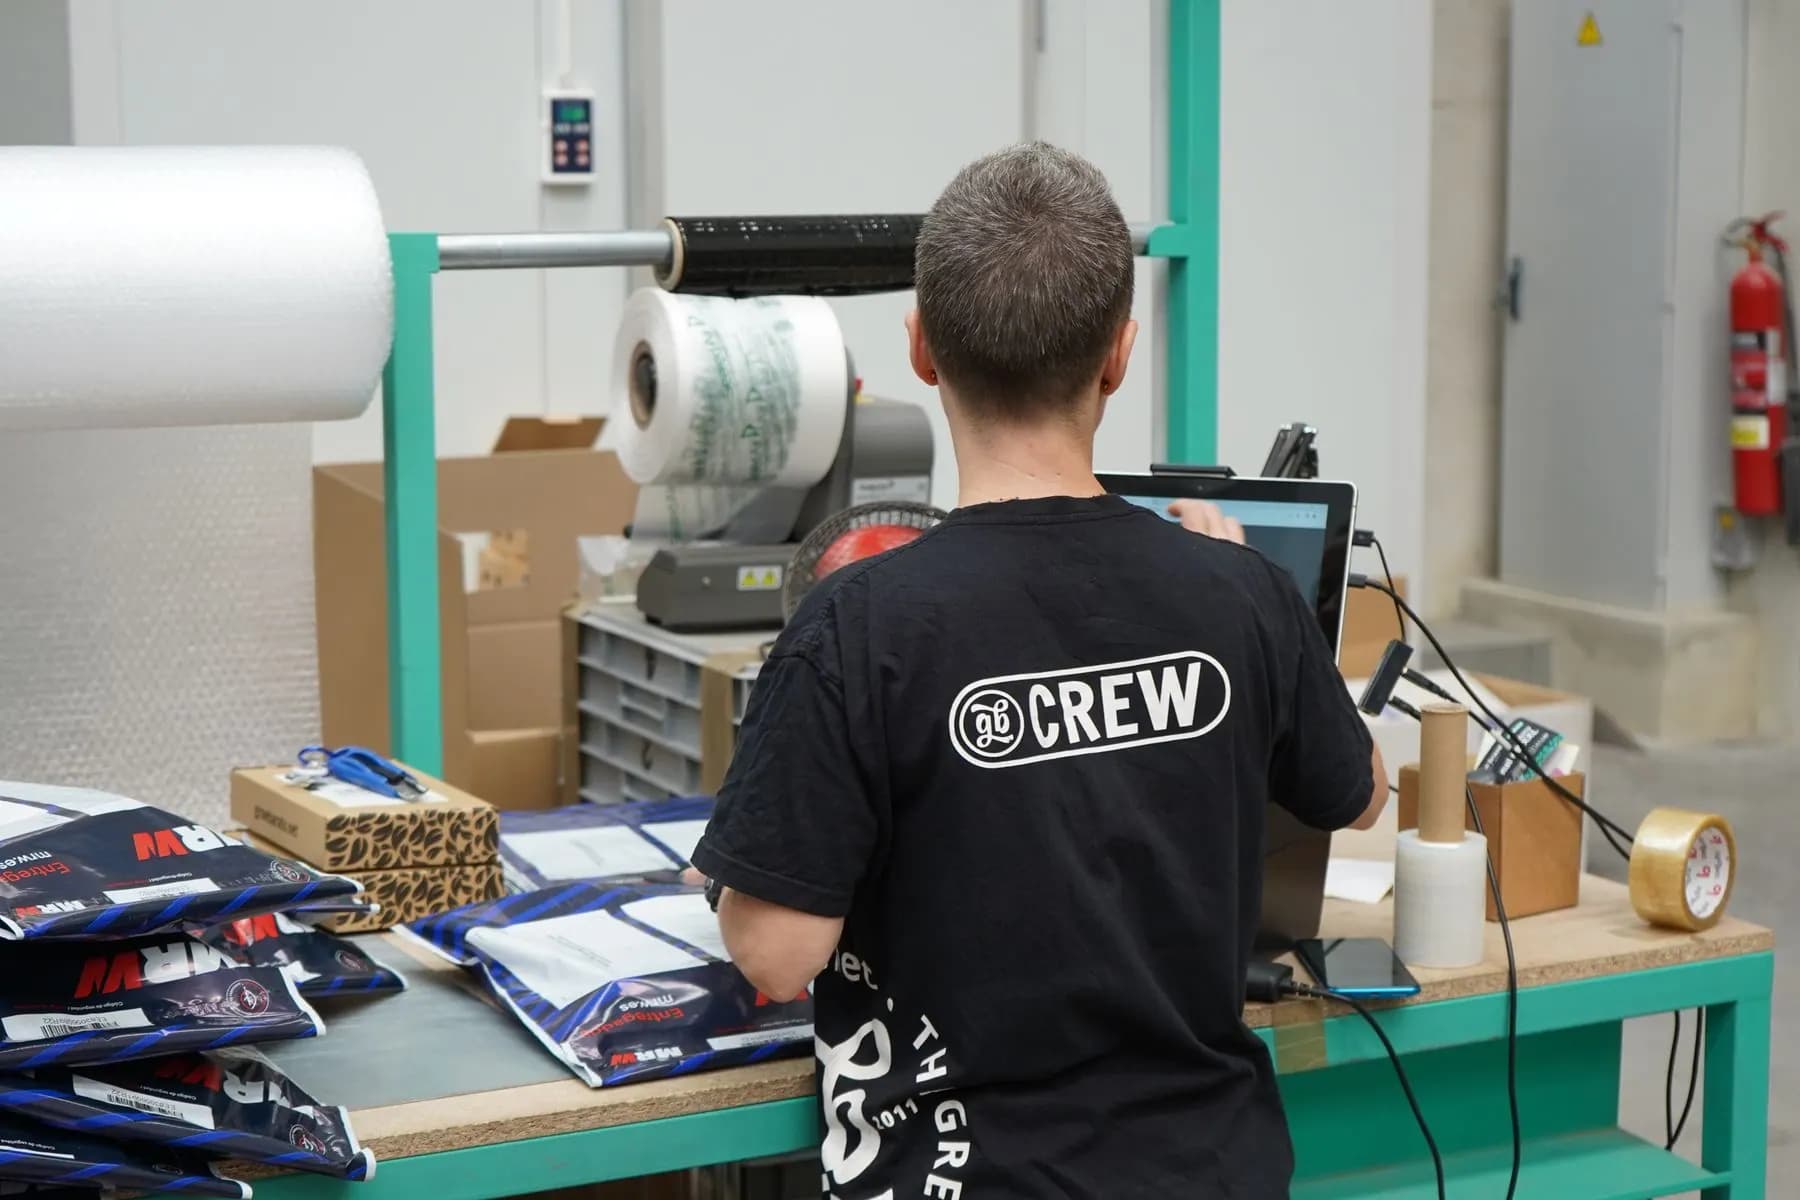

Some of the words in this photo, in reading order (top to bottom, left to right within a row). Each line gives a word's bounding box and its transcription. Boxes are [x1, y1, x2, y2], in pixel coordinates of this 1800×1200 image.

[1029, 661, 1202, 749] CREW
[911, 1014, 954, 1096] TH
[872, 1098, 919, 1131] 2011
